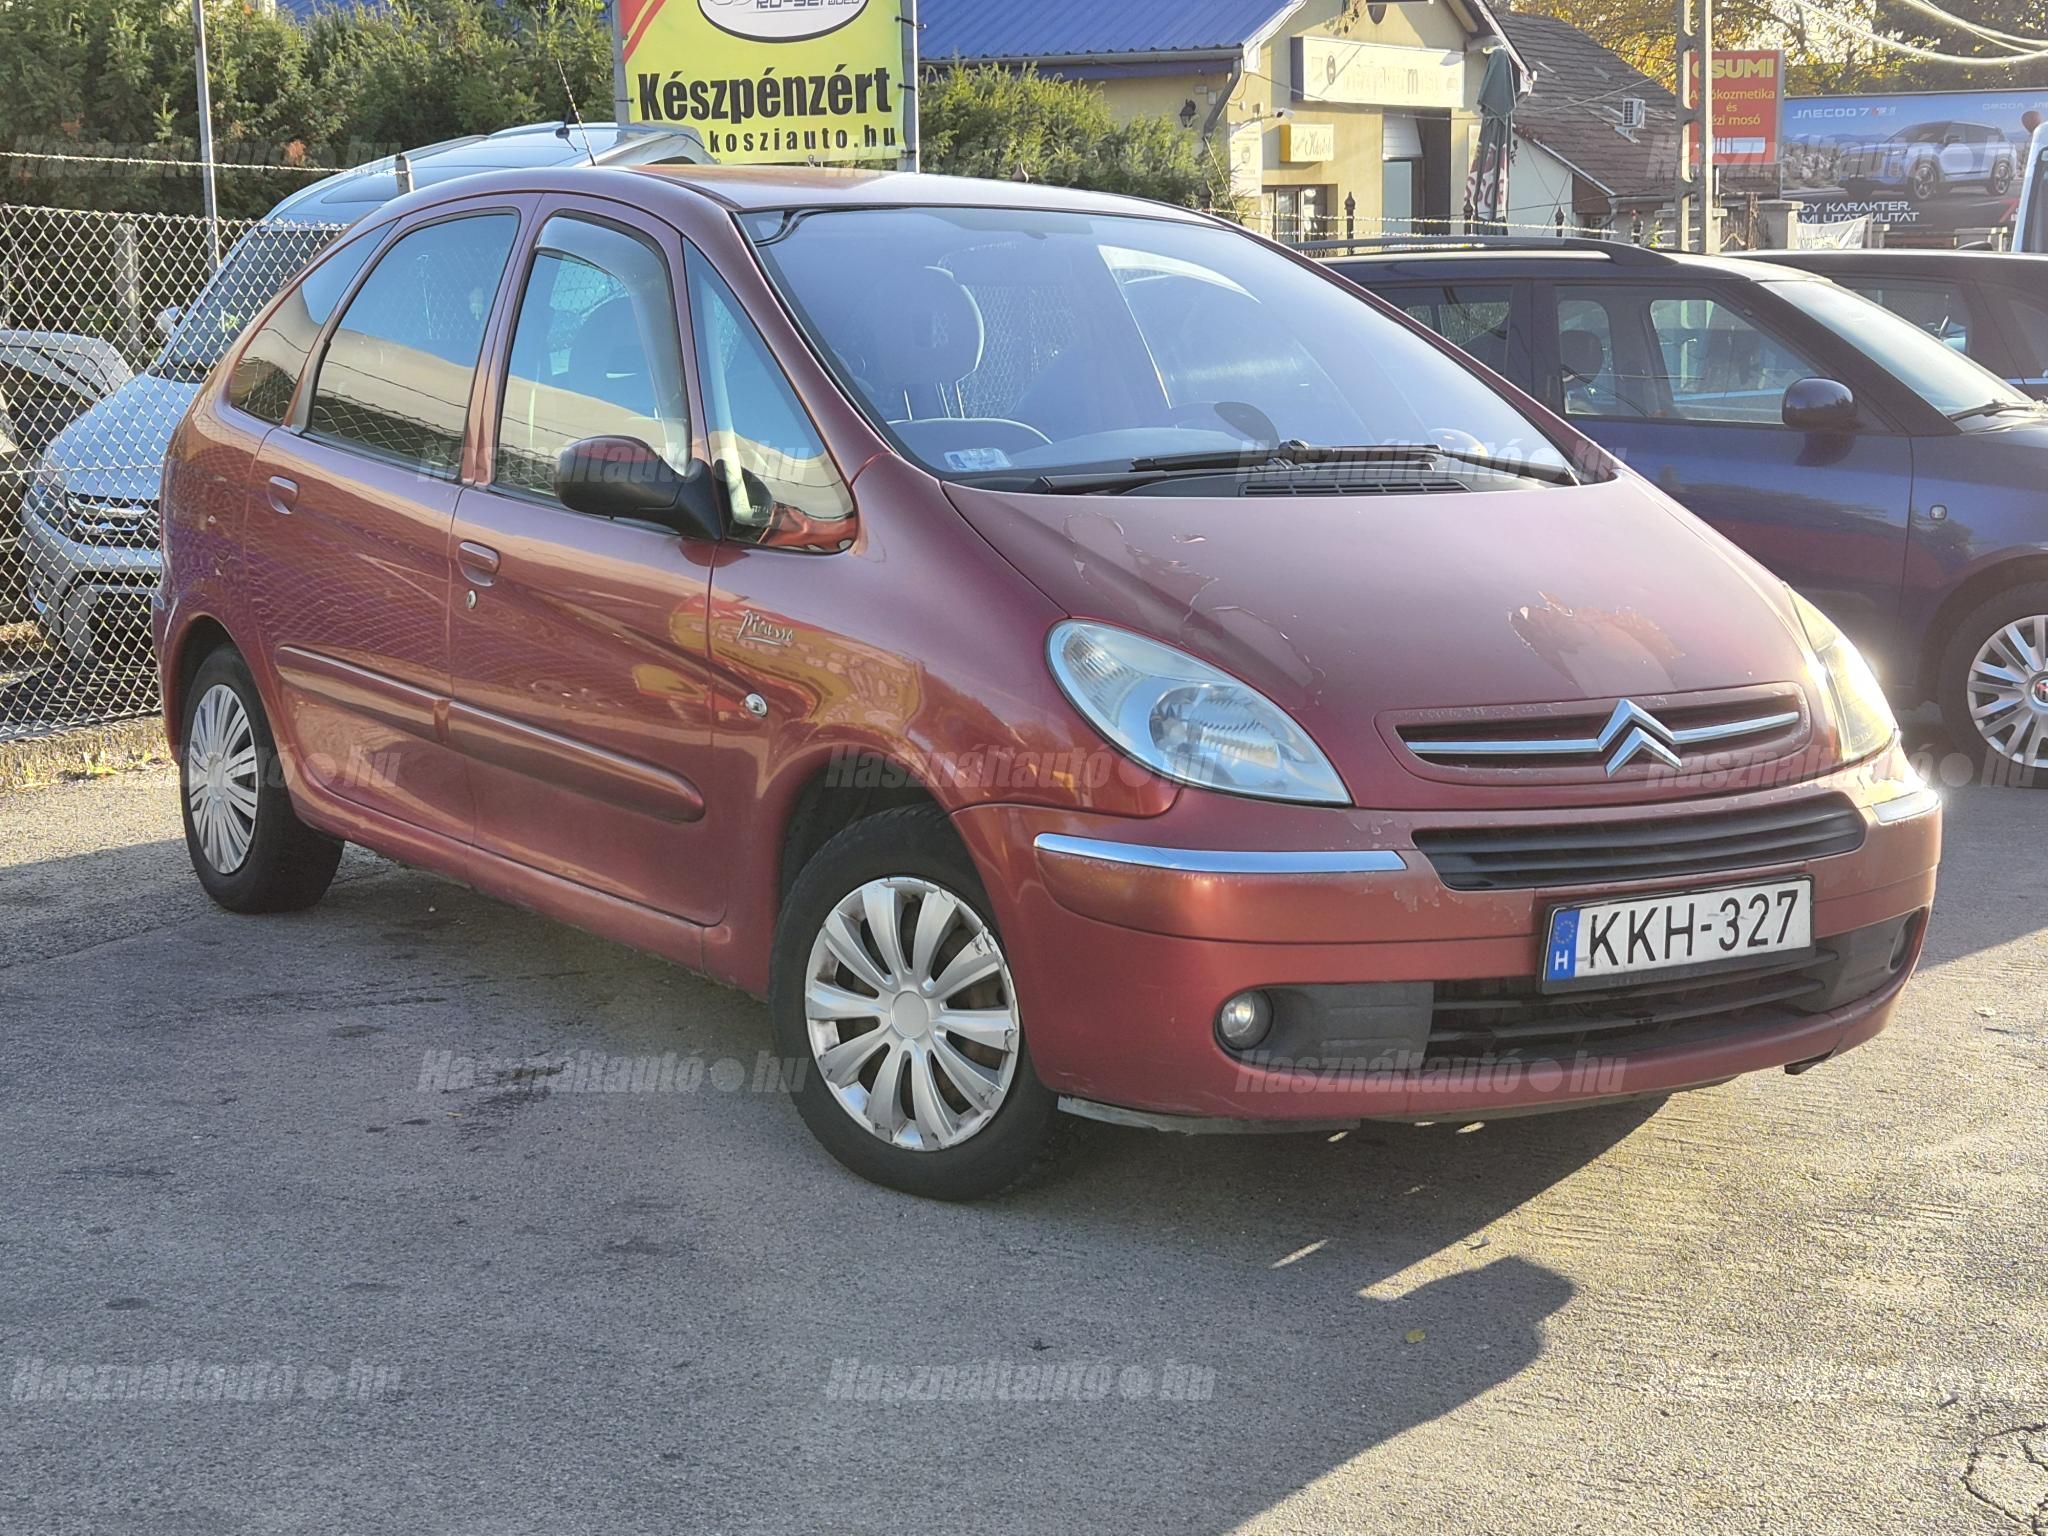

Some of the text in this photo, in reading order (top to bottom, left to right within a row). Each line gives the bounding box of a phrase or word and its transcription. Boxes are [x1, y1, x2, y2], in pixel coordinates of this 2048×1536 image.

[638, 64, 892, 124] Készpénzért
[1726, 103, 1738, 112] és
[1728, 114, 1761, 125] mosó
[709, 124, 896, 152] kosziauto.hu
[1554, 889, 1799, 971] H KKH-327
